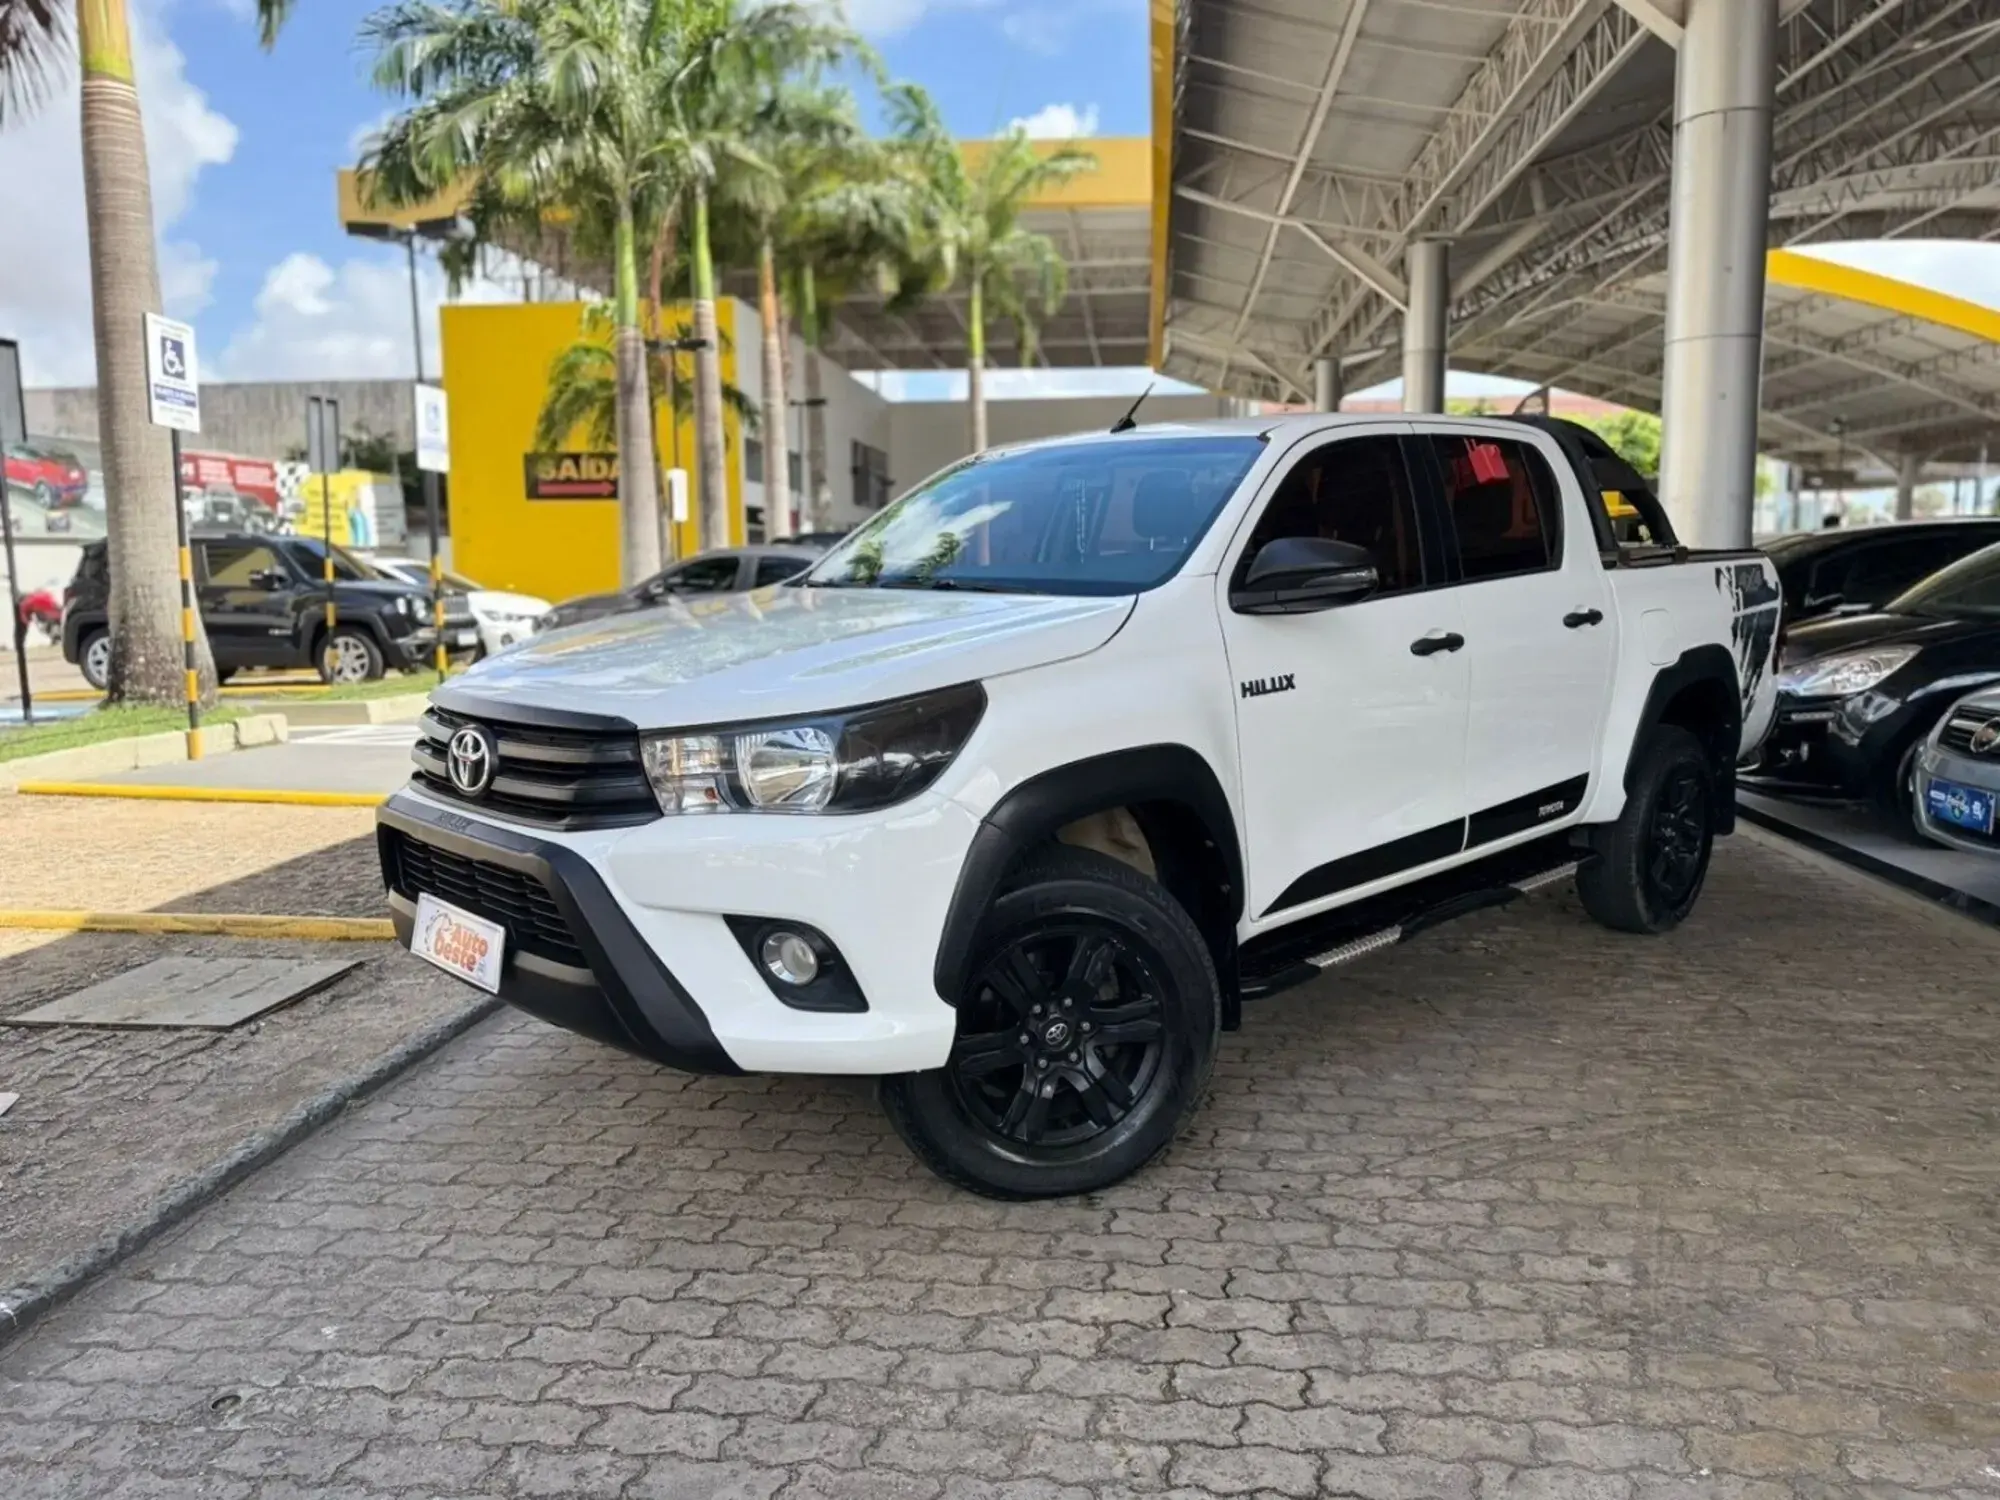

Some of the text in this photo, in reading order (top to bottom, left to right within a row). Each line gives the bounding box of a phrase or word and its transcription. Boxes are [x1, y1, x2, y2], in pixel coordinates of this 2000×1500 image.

[1241, 673, 1296, 698] HILUX
[434, 927, 478, 972] Oeste
[450, 923, 488, 957] Auto
